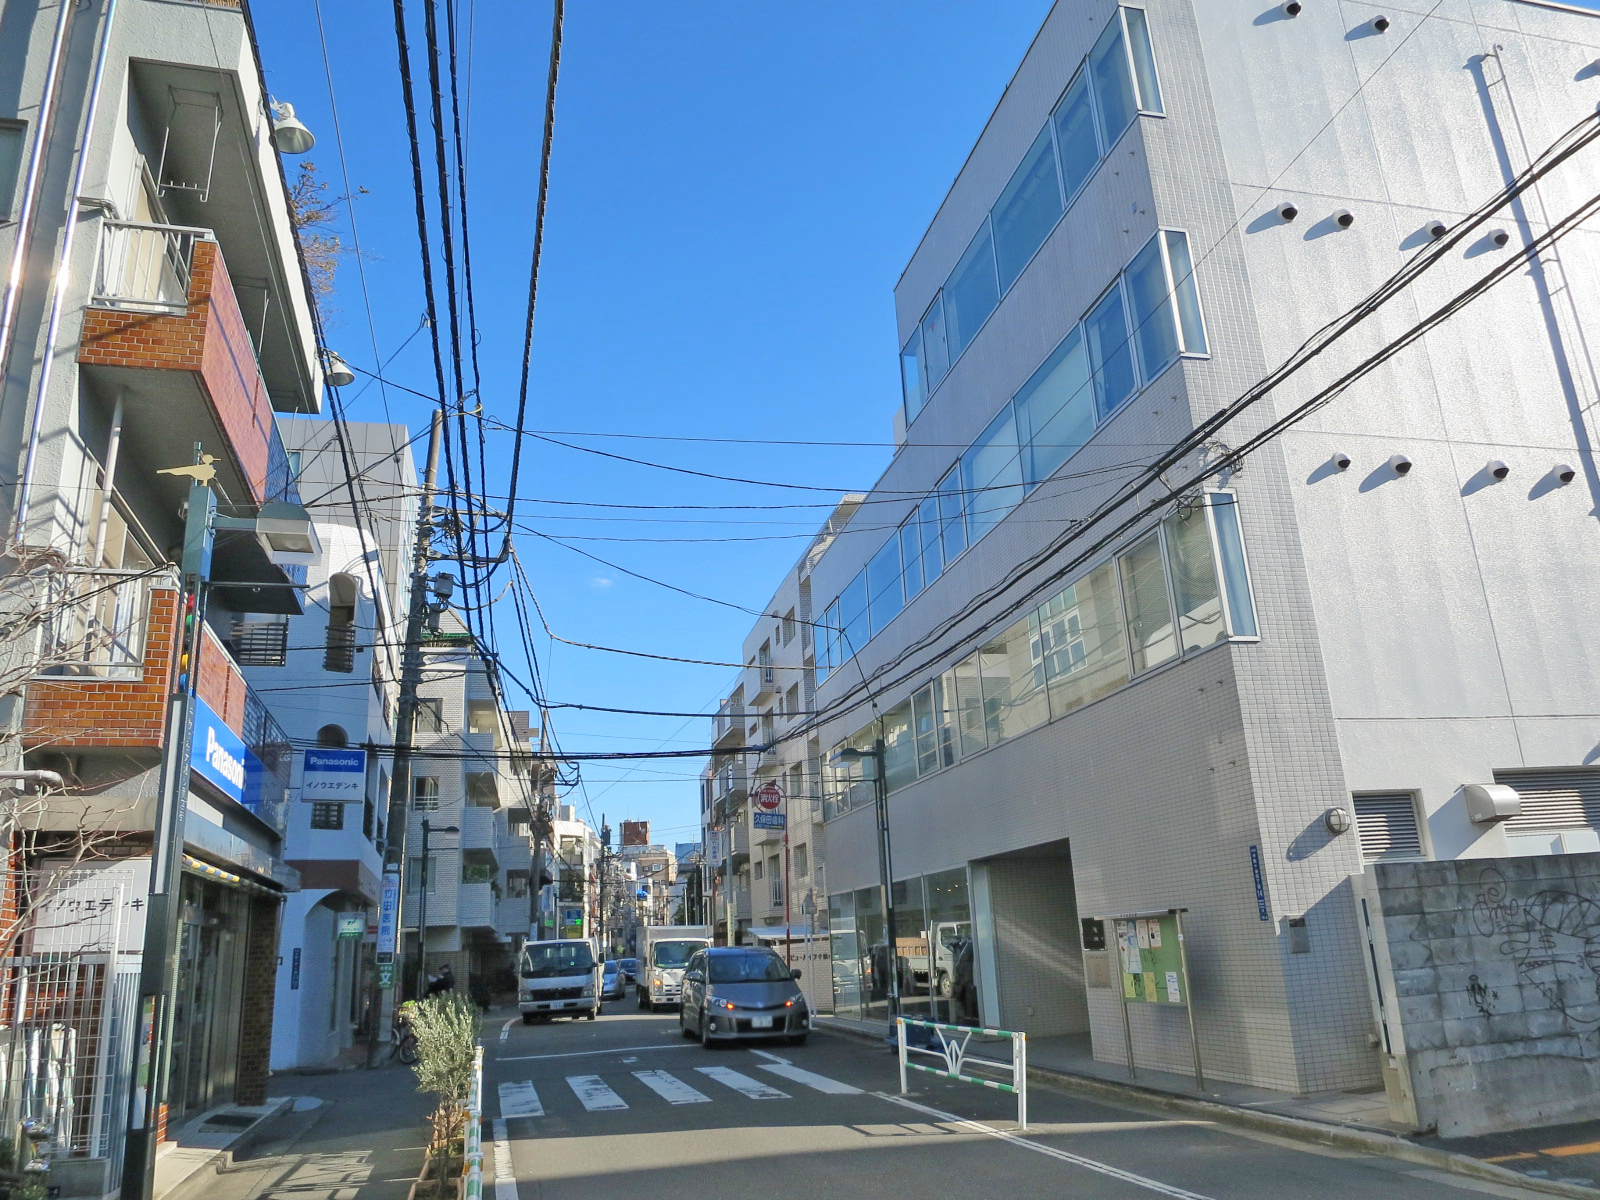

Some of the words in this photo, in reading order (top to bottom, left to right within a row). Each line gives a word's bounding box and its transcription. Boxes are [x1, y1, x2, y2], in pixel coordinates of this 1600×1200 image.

[310, 757, 359, 766] Panasonic
[306, 781, 359, 790] イノウエデンキ
[760, 793, 779, 803] 消火栓
[754, 814, 784, 826] 久保田歯科
[381, 888, 393, 936] 竹田医院
[379, 971, 392, 985] 文
